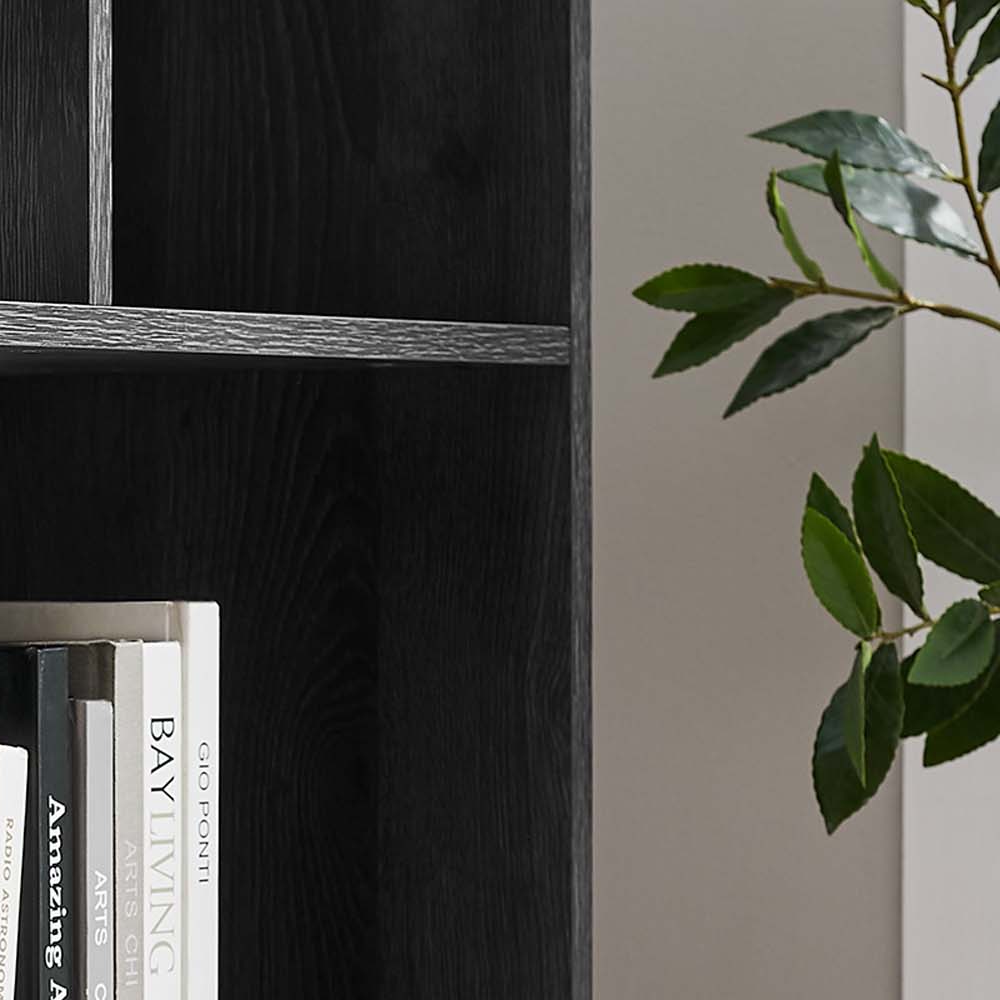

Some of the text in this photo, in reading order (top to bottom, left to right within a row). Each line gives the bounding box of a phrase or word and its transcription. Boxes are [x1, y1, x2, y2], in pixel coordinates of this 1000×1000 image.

[3, 818, 15, 881] RADIO
[198, 742, 210, 882] GIO PONTI
[45, 795, 67, 969] Amazing
[94, 870, 108, 946] ARTS
[124, 839, 138, 918] ARTS
[124, 934, 139, 986] CHI
